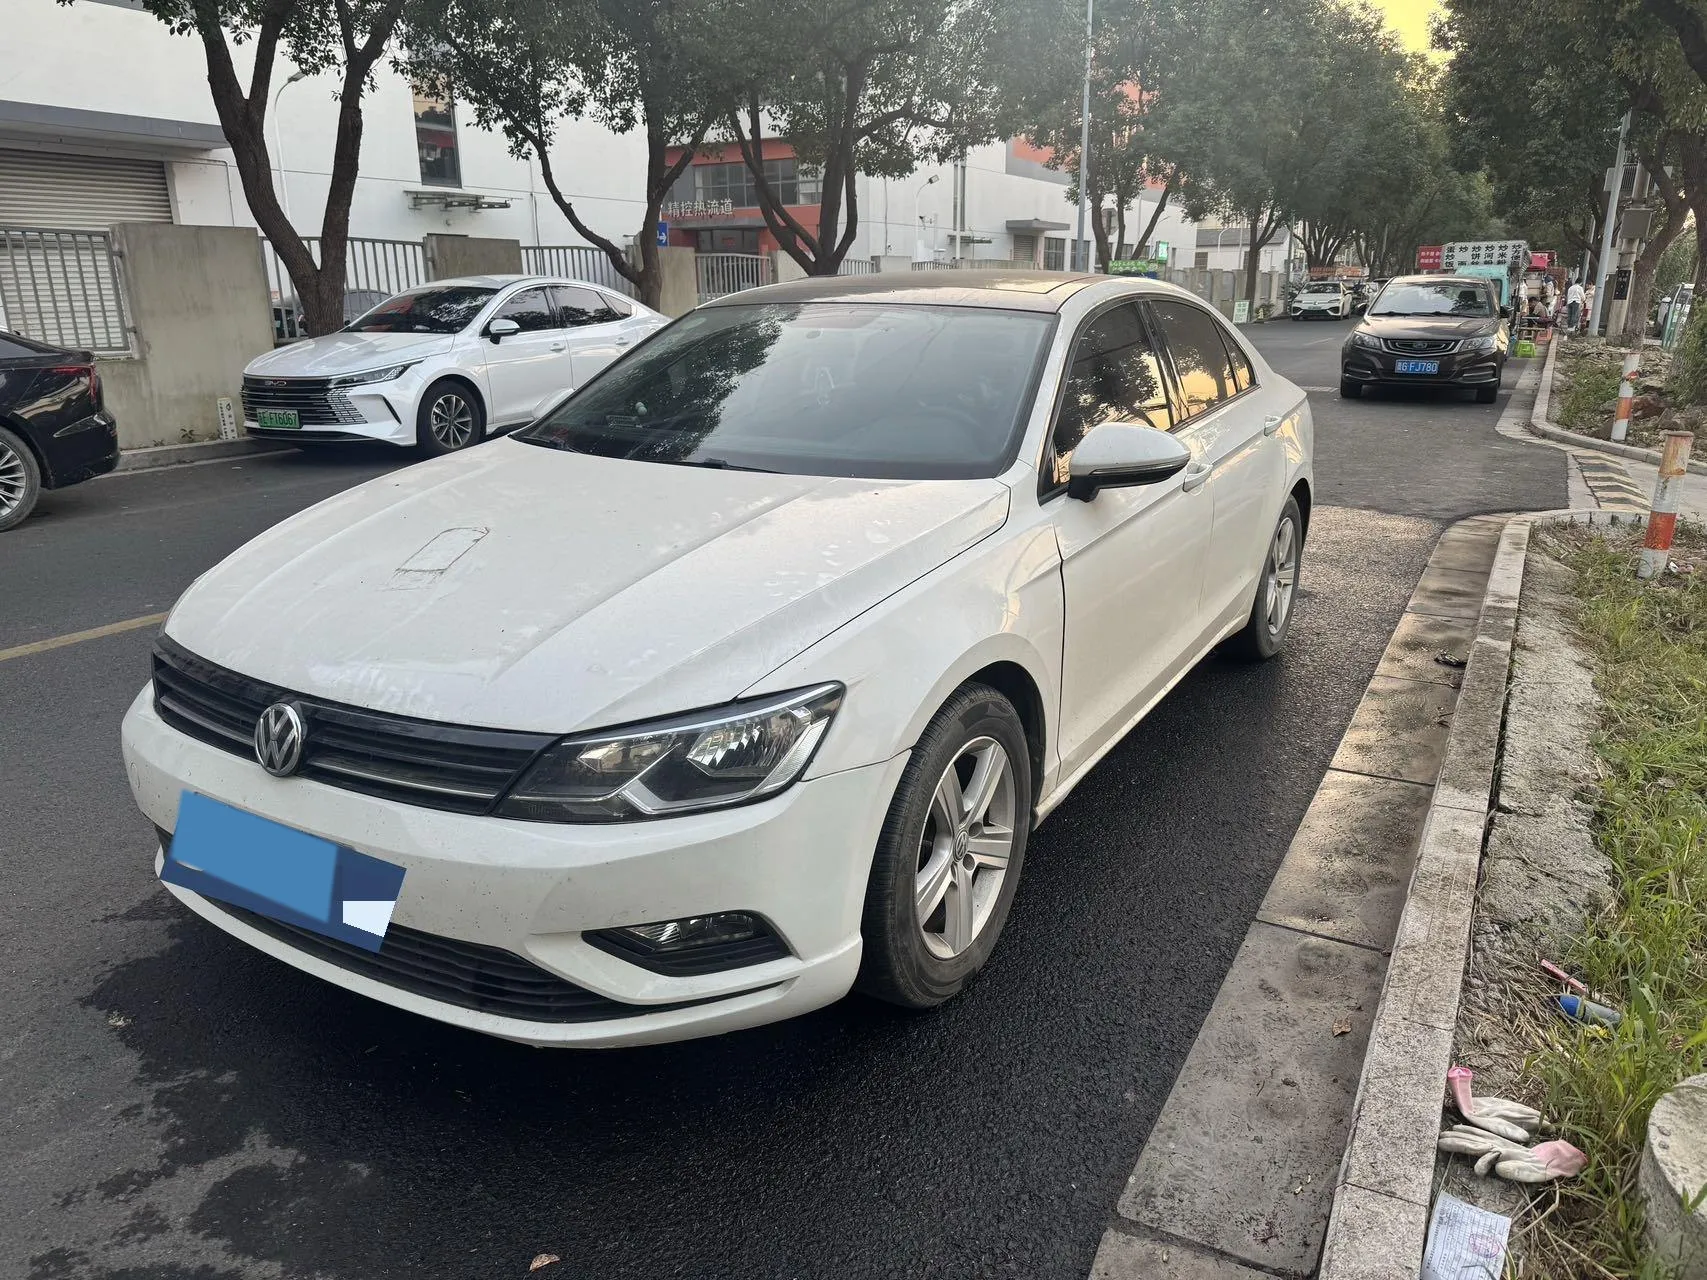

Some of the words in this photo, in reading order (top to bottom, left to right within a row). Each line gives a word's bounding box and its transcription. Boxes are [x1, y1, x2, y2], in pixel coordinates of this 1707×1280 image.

[668, 198, 734, 218] 精控热流道
